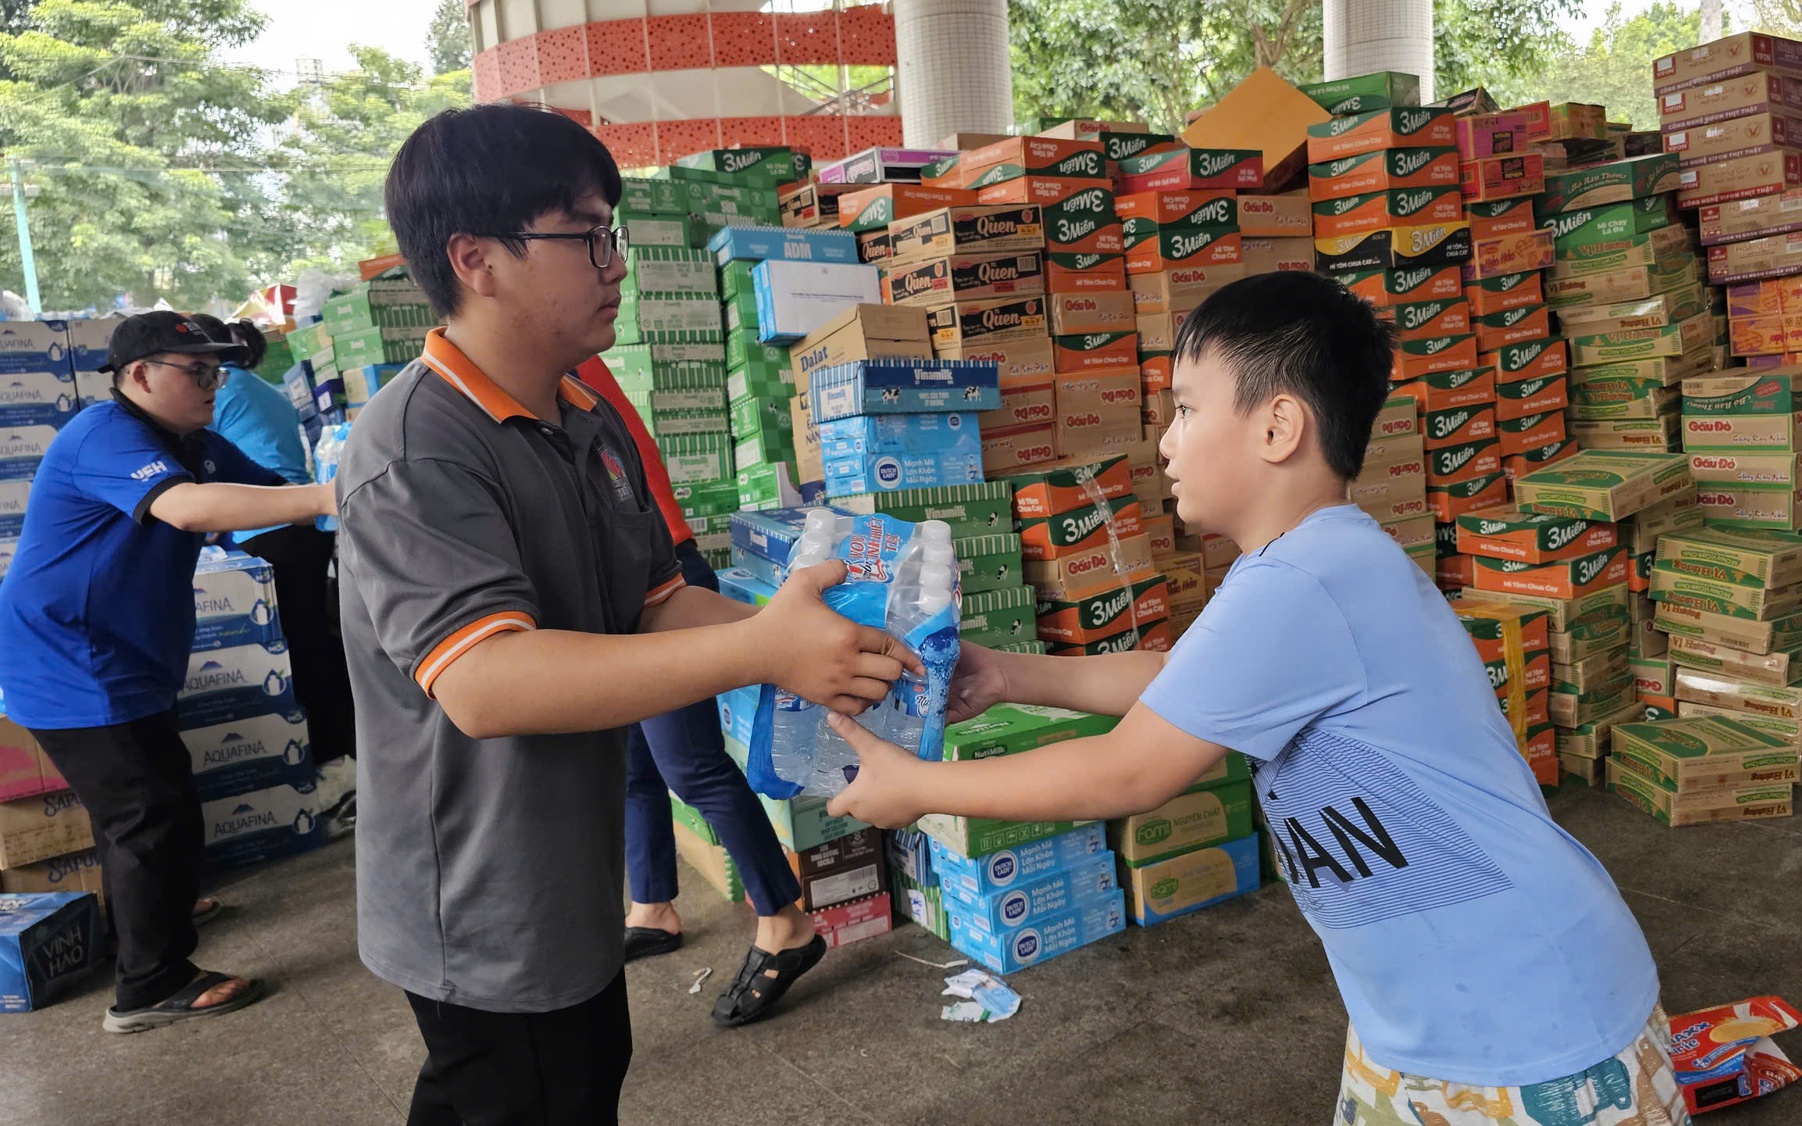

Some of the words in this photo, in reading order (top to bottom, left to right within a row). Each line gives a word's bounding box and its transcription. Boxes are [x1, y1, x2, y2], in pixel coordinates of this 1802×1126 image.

[784, 242, 812, 259] ADM
[801, 346, 829, 372] Dalat
[914, 369, 954, 384] Vinamilk
[130, 461, 168, 480] UEH
[925, 505, 966, 519] Vinamilk
[196, 597, 236, 612] AFINA
[203, 741, 268, 766] AQUAFINA
[214, 811, 277, 838] AQUAFINA
